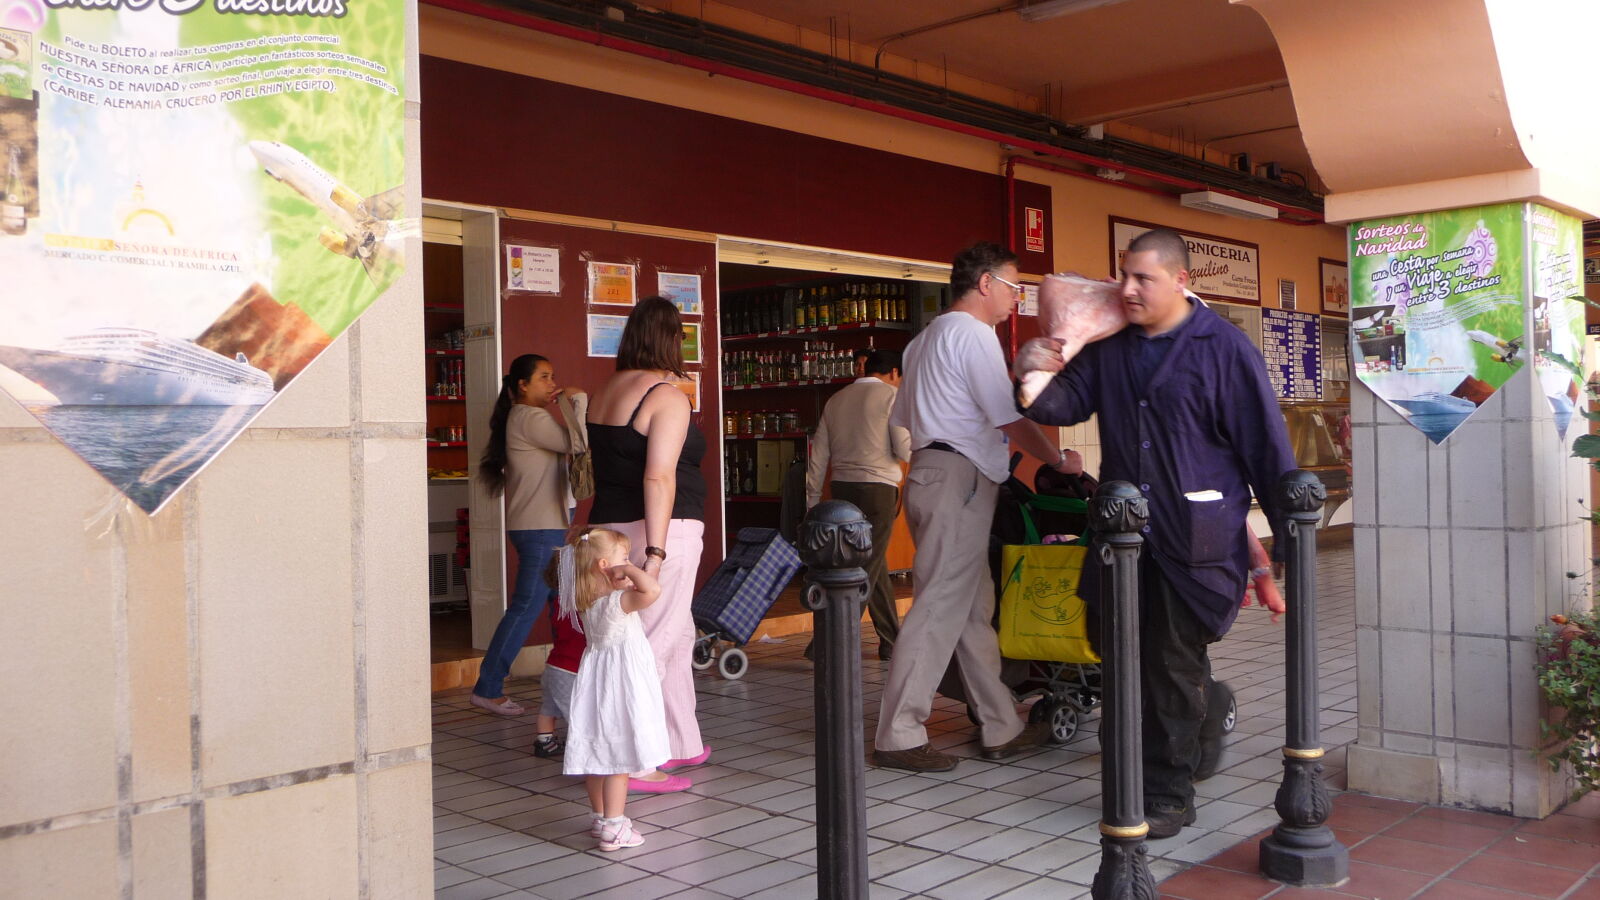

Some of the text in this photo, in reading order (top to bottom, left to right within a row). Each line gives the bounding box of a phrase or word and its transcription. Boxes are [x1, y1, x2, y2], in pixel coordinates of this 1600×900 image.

[40, 42, 98, 69] NUESTRA
[102, 60, 150, 75] SEÑORA
[154, 65, 168, 75] DE
[172, 60, 212, 73] ÁFRICA
[223, 55, 257, 68] participa
[259, 54, 269, 62] en
[271, 51, 315, 60] fantásticos
[317, 52, 344, 60] sorteos
[346, 55, 386, 72] semanales
[65, 35, 339, 58] Pide tu BOLETO al realizar tus compras en el conjunto comercial
[41, 62, 54, 73] de
[57, 66, 105, 88] CESTAS
[109, 80, 124, 91] DE
[128, 80, 180, 92] NAVIDAD
[189, 80, 212, 90] como
[213, 76, 240, 86] sorteo
[276, 67, 295, 77] viaje
[304, 66, 325, 76] elegir
[327, 67, 347, 76] entre
[349, 70, 363, 81] tres
[365, 74, 398, 94] destinos
[43, 78, 337, 110] (CARIBE, ALEMANIA CRUCERO POR EL RHIN Y EGIPTO).
[1355, 223, 1424, 241] Sorteos de
[1355, 232, 1427, 257] Navidad
[1186, 239, 1251, 263] RNICERIA
[1372, 271, 1388, 282] una
[1390, 256, 1426, 276] Cesta
[1425, 256, 1440, 271] por
[1386, 262, 1478, 301] y un Viaje a elegir
[1406, 274, 1501, 307] entre 3 destinos
